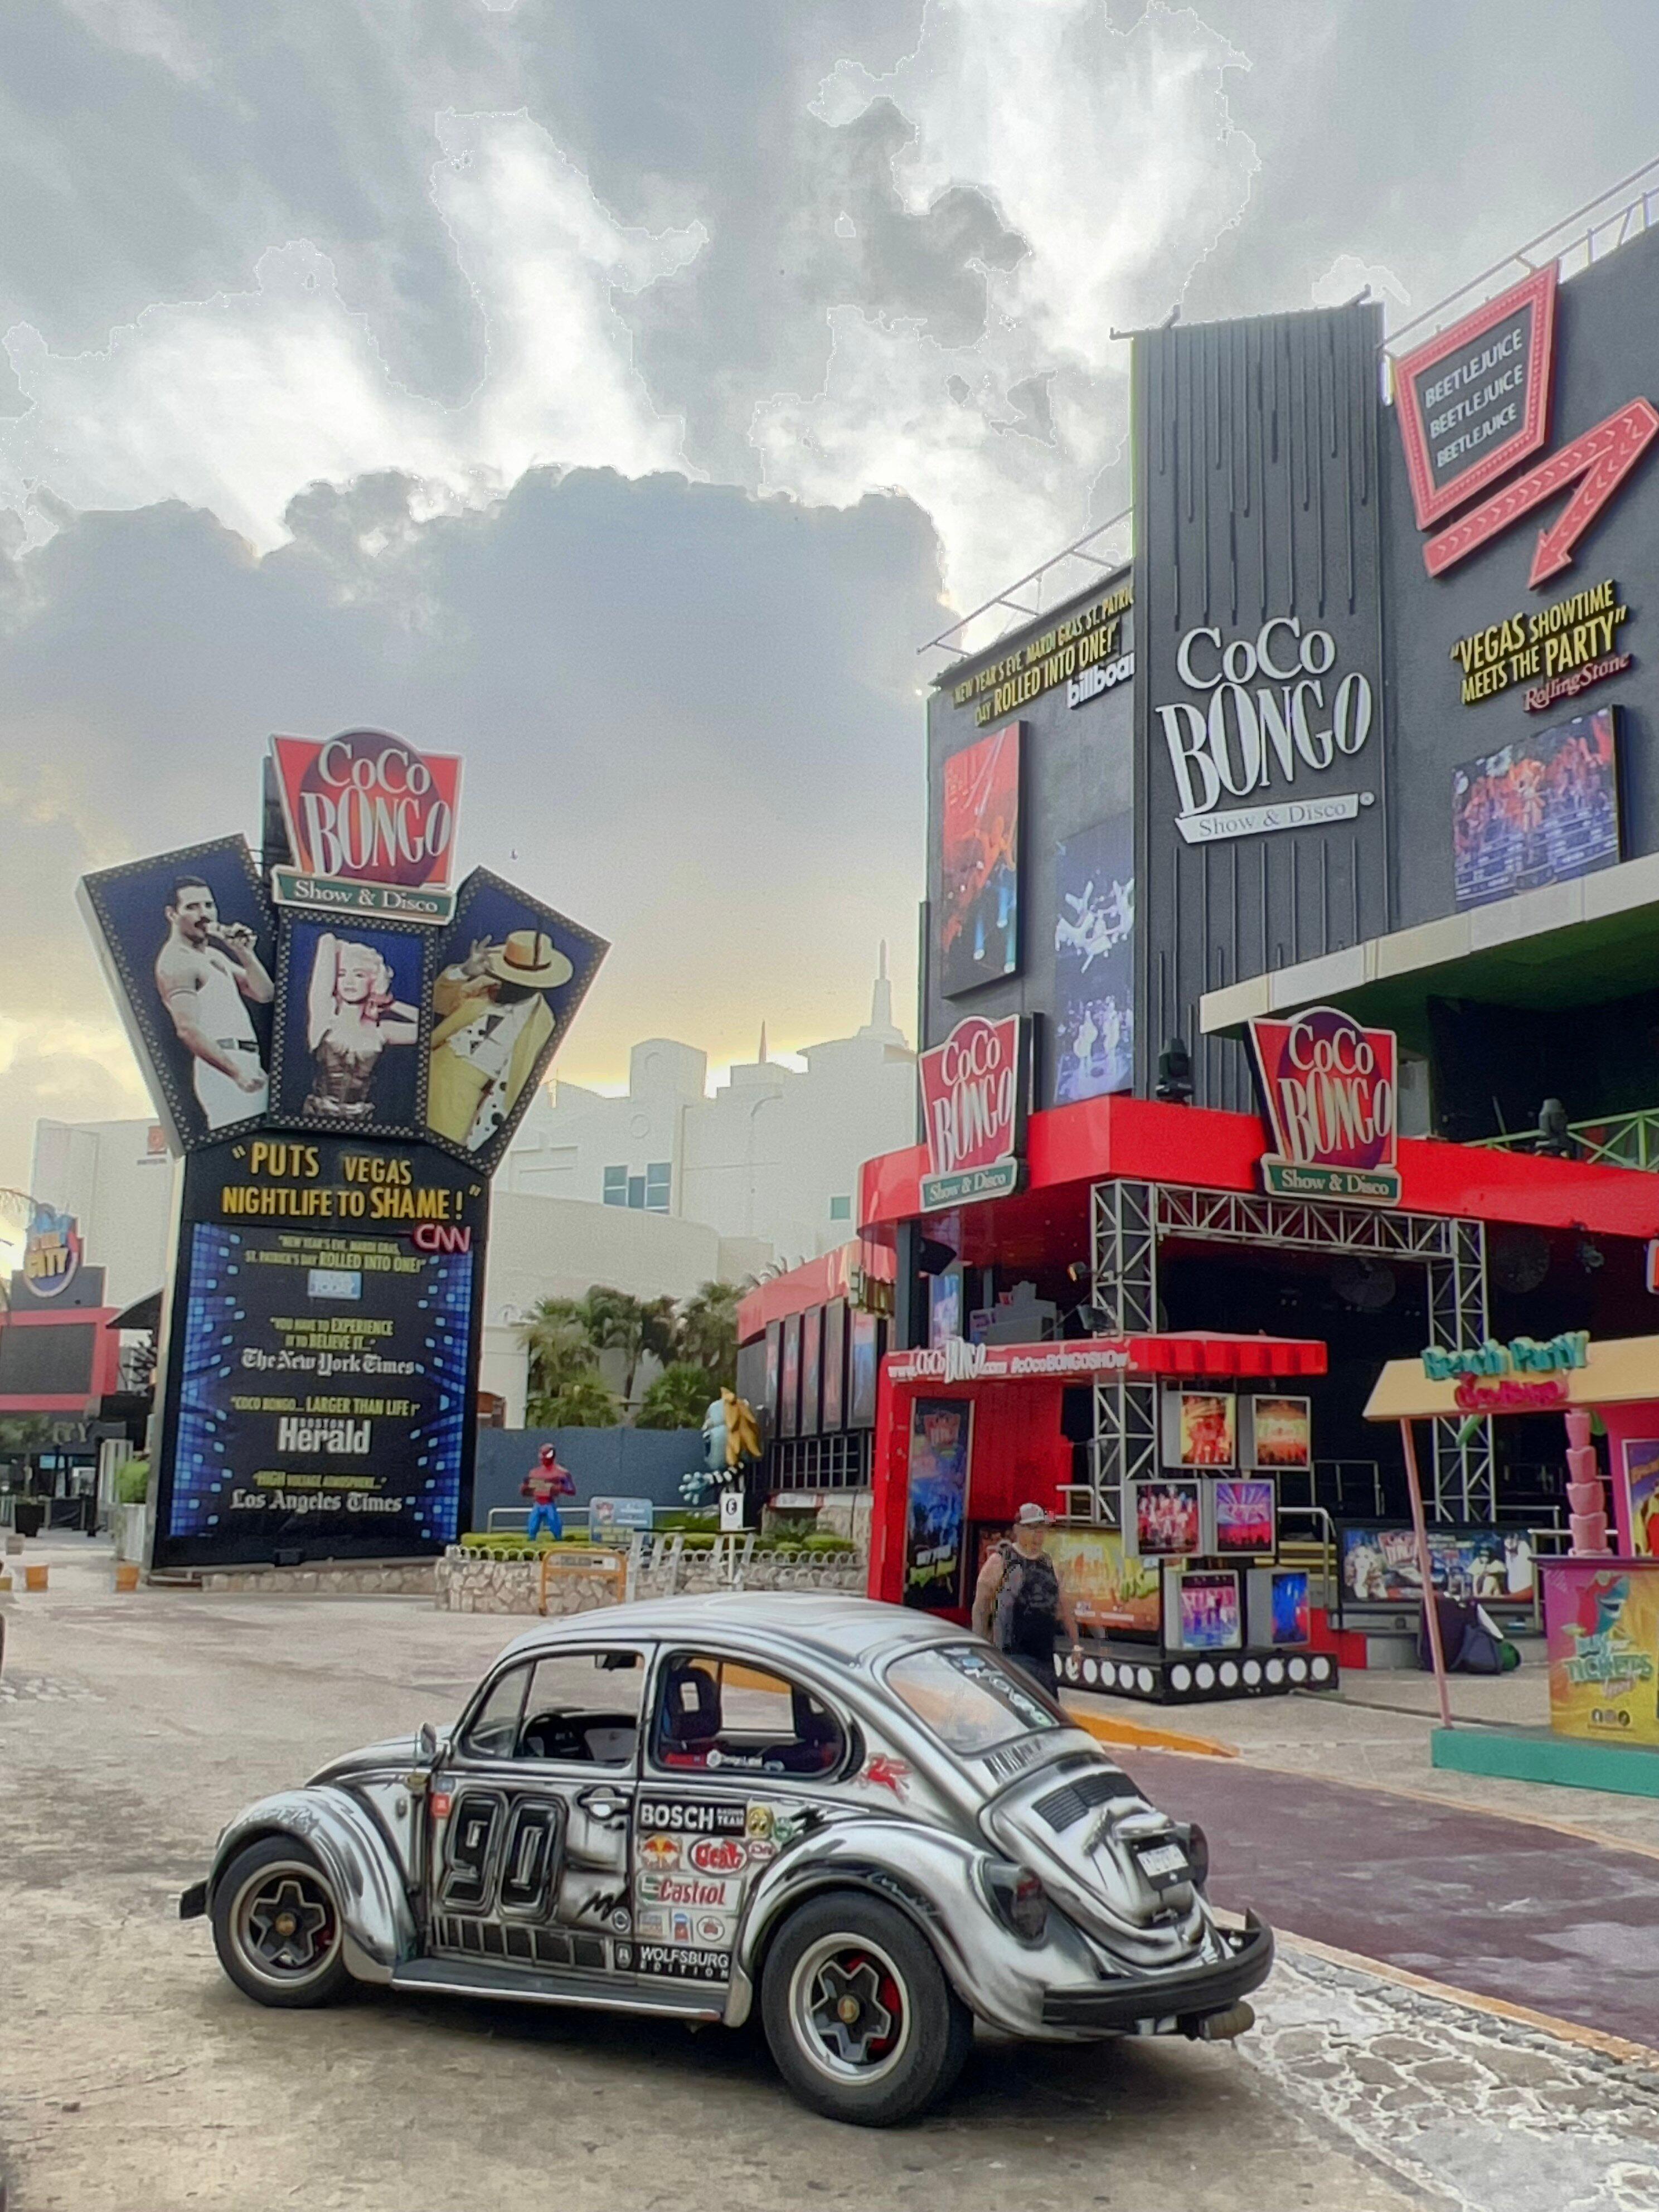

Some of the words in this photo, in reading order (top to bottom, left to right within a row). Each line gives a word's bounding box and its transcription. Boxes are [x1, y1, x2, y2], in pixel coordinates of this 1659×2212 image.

[1424, 328, 1524, 409] BEETLEJUICE
[1429, 363, 1524, 439] BEETLEJUICE
[1436, 402, 1517, 468] BEETLEJUICE
[1529, 579, 1615, 643] SHOWTIME
[974, 701, 992, 726] DAY
[994, 666, 1041, 717] ROLLED
[1043, 646, 1076, 689] INTO
[1461, 661, 1508, 705] MEETS
[1510, 645, 1540, 682] THE
[1154, 672, 1372, 819] BONGO
[300, 786, 452, 877] BONGO
[1199, 817, 1254, 837] Show
[1263, 809, 1280, 828] &
[1288, 802, 1347, 824] Disco
[294, 880, 352, 903] Show
[358, 889, 376, 906] &
[383, 890, 438, 913] Disco
[932, 1066, 1013, 1173] BONGO
[1277, 1066, 1393, 1166] BONGO
[343, 1156, 413, 1186] VEGAS
[929, 1181, 958, 1203] Show
[961, 1177, 972, 1193] &
[974, 1170, 1007, 1191] Disco
[1282, 1168, 1326, 1190] Show
[1328, 1174, 1343, 1192] &
[1347, 1175, 1390, 1196] Disco
[221, 1186, 333, 1217] NIGHTLIFE
[337, 1191, 366, 1217] TO
[414, 1223, 471, 1254] CNN
[318, 1251, 362, 1269] ROLLED
[363, 1254, 392, 1272] INTO
[308, 1333, 351, 1350] BELIEVE
[331, 1317, 394, 1337] EXPERIENCE
[241, 1347, 276, 1372] The
[278, 1350, 316, 1371] New
[317, 1353, 361, 1376] York
[362, 1353, 415, 1375] Times
[306, 1395, 352, 1414] LARGER
[353, 1398, 384, 1415] THAN
[278, 1416, 372, 1454] Herald
[299, 1417, 346, 1429] BOSTON
[229, 1488, 266, 1510] Los
[268, 1489, 342, 1515] Angeles
[346, 1491, 402, 1512] Times
[1564, 1652, 1653, 1682] TICKETS
[641, 1803, 715, 1831] BOSCH
[658, 1878, 726, 1905] Castrol
[641, 1946, 729, 1968] WOLFSBURG
[641, 1961, 729, 1978] EDITION
